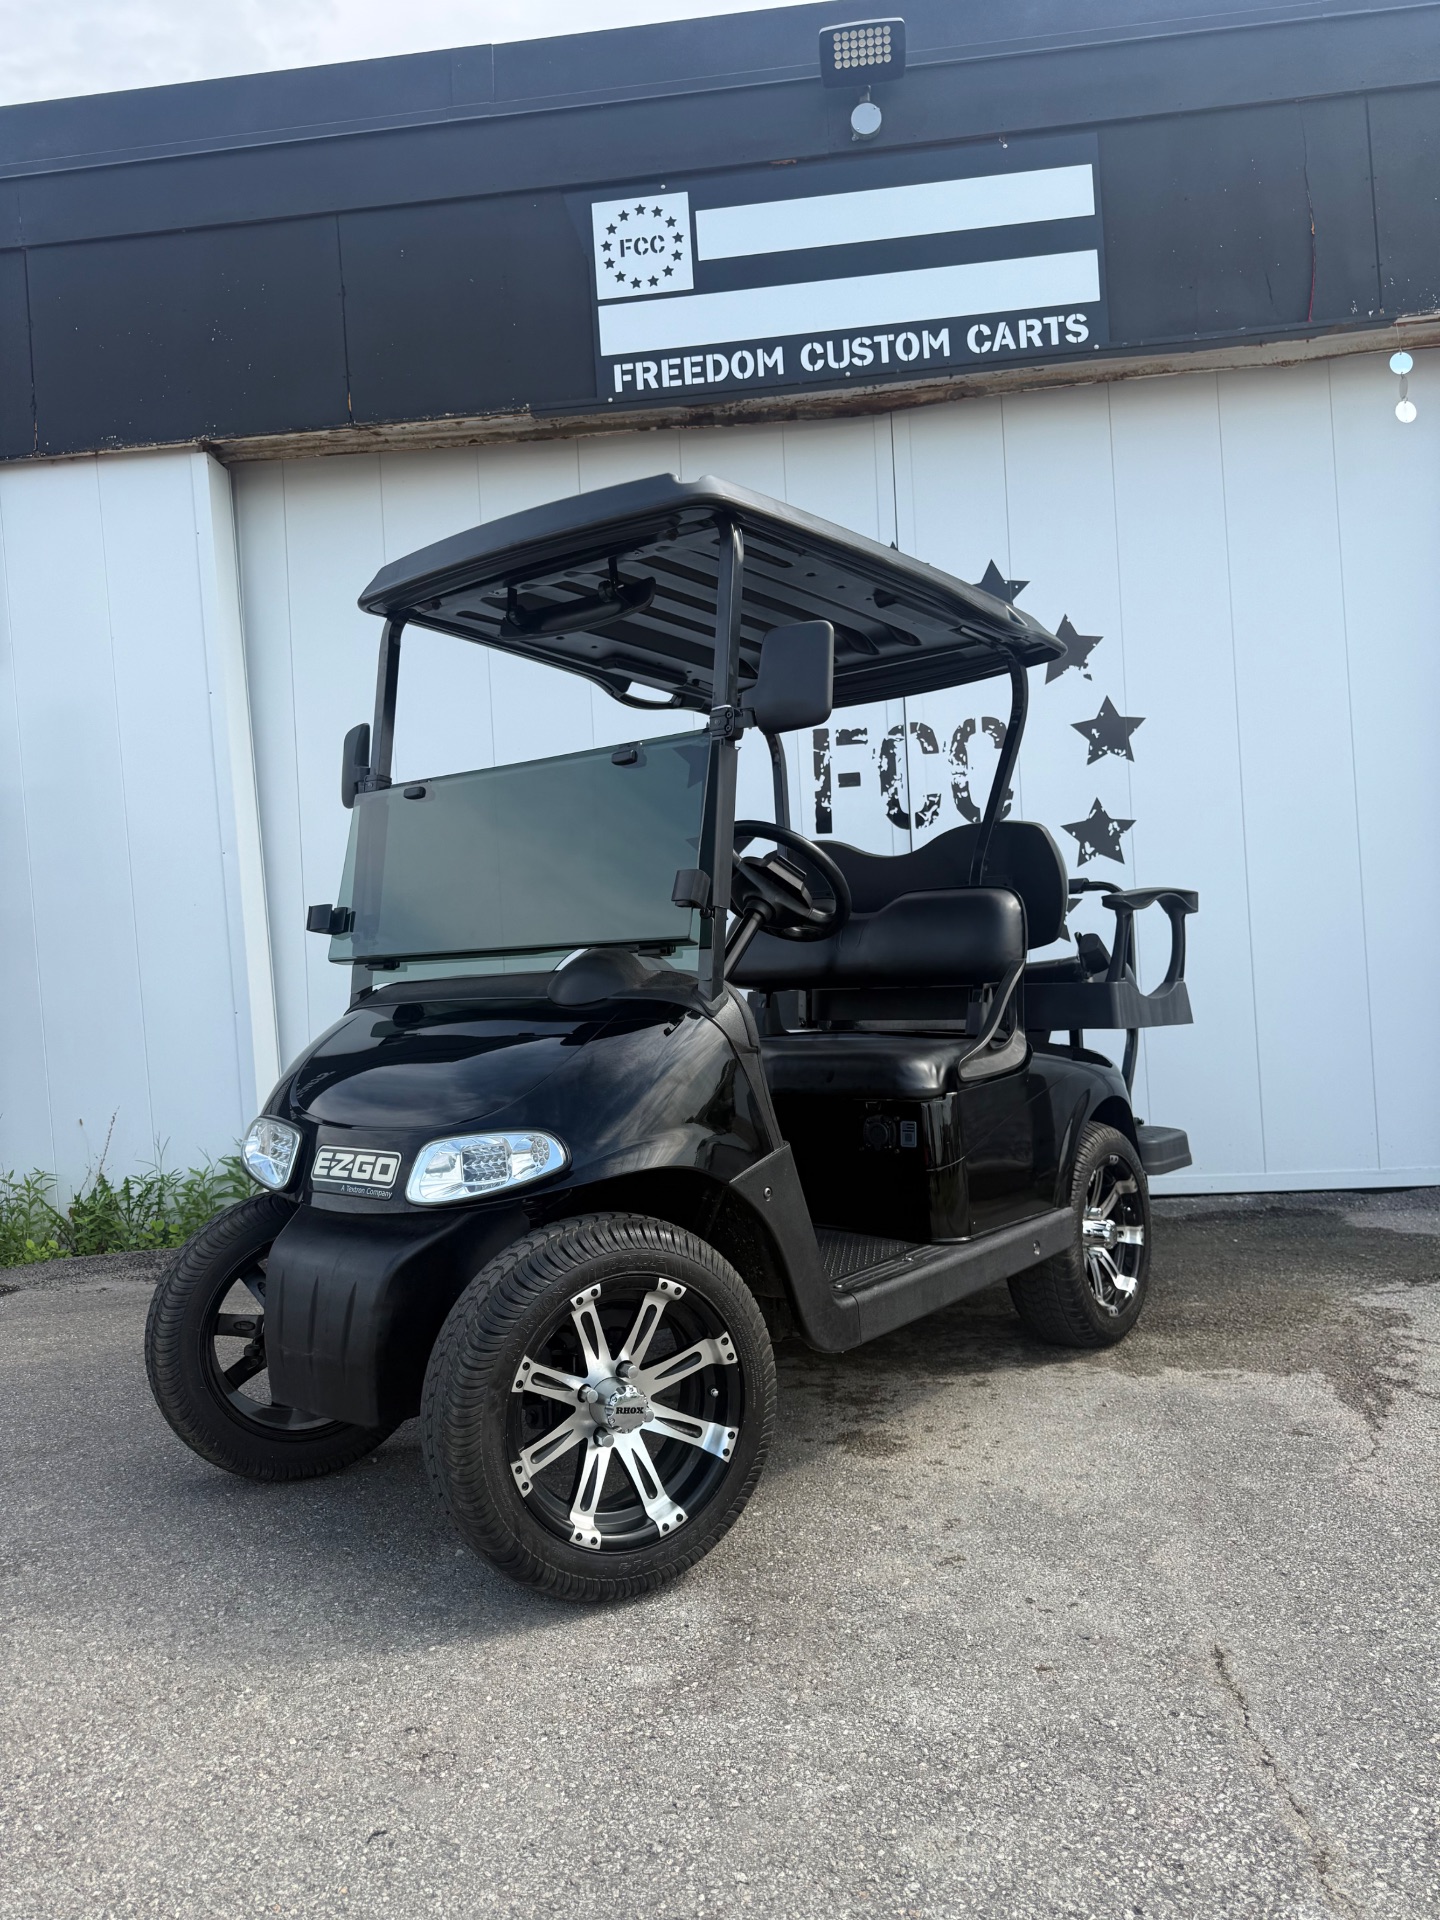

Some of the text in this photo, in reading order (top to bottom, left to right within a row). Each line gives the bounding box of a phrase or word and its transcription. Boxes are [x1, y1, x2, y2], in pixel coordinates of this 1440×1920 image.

[619, 234, 666, 258] FCC
[613, 313, 1089, 393] FREEDOM CUSTOM CARTS
[812, 716, 1014, 834] FCC
[340, 1184, 393, 1198] A Textron Company
[615, 1406, 645, 1415] RHOX
